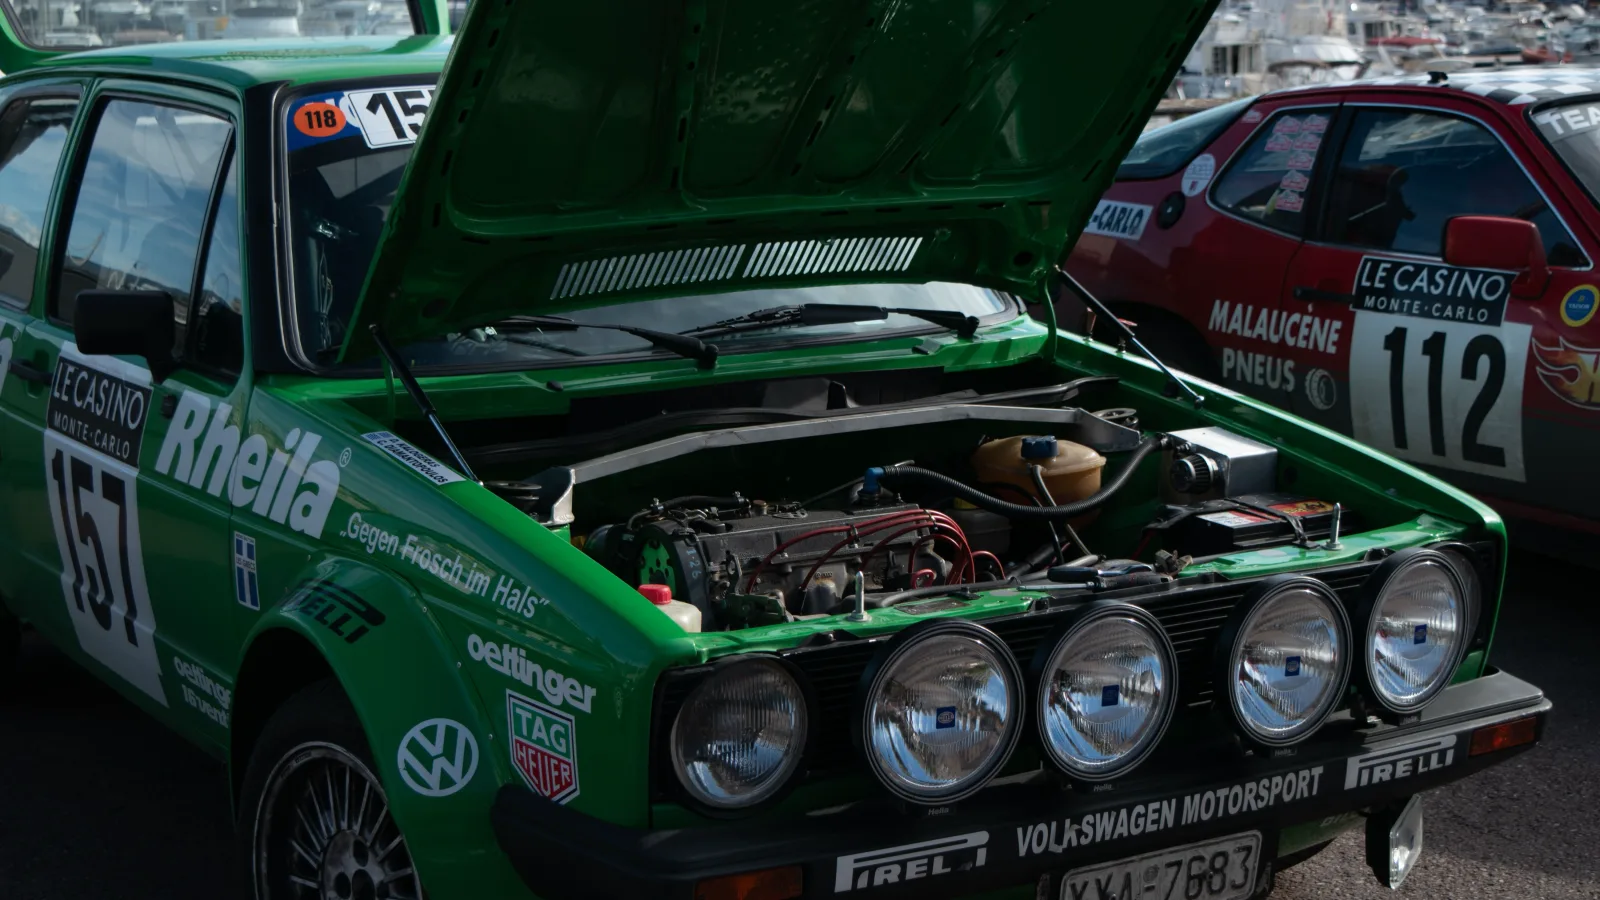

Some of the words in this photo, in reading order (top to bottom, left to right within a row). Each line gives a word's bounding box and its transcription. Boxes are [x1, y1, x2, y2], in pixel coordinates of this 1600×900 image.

[304, 109, 337, 129] 118
[365, 90, 435, 140] 15
[1086, 204, 1144, 236] -CARLO
[1360, 261, 1392, 289] LE
[1393, 264, 1506, 302] CASINO
[53, 361, 79, 402] LE
[73, 370, 145, 430] CASINO
[1222, 347, 1296, 393] PNEUS
[1382, 325, 1507, 468] 112
[51, 447, 139, 648] 157
[400, 534, 463, 588] Frosch
[464, 569, 491, 597] im
[467, 633, 597, 714] oettinger
[515, 707, 567, 754] TAG
[516, 742, 571, 799] HEUER
[1344, 734, 1457, 790] PIRELLI
[928, 806, 950, 816] Hella
[1016, 797, 1177, 857] VOLKSWAGEN
[1181, 765, 1324, 826] MOTORSPORT
[834, 830, 990, 893] PIRELI
